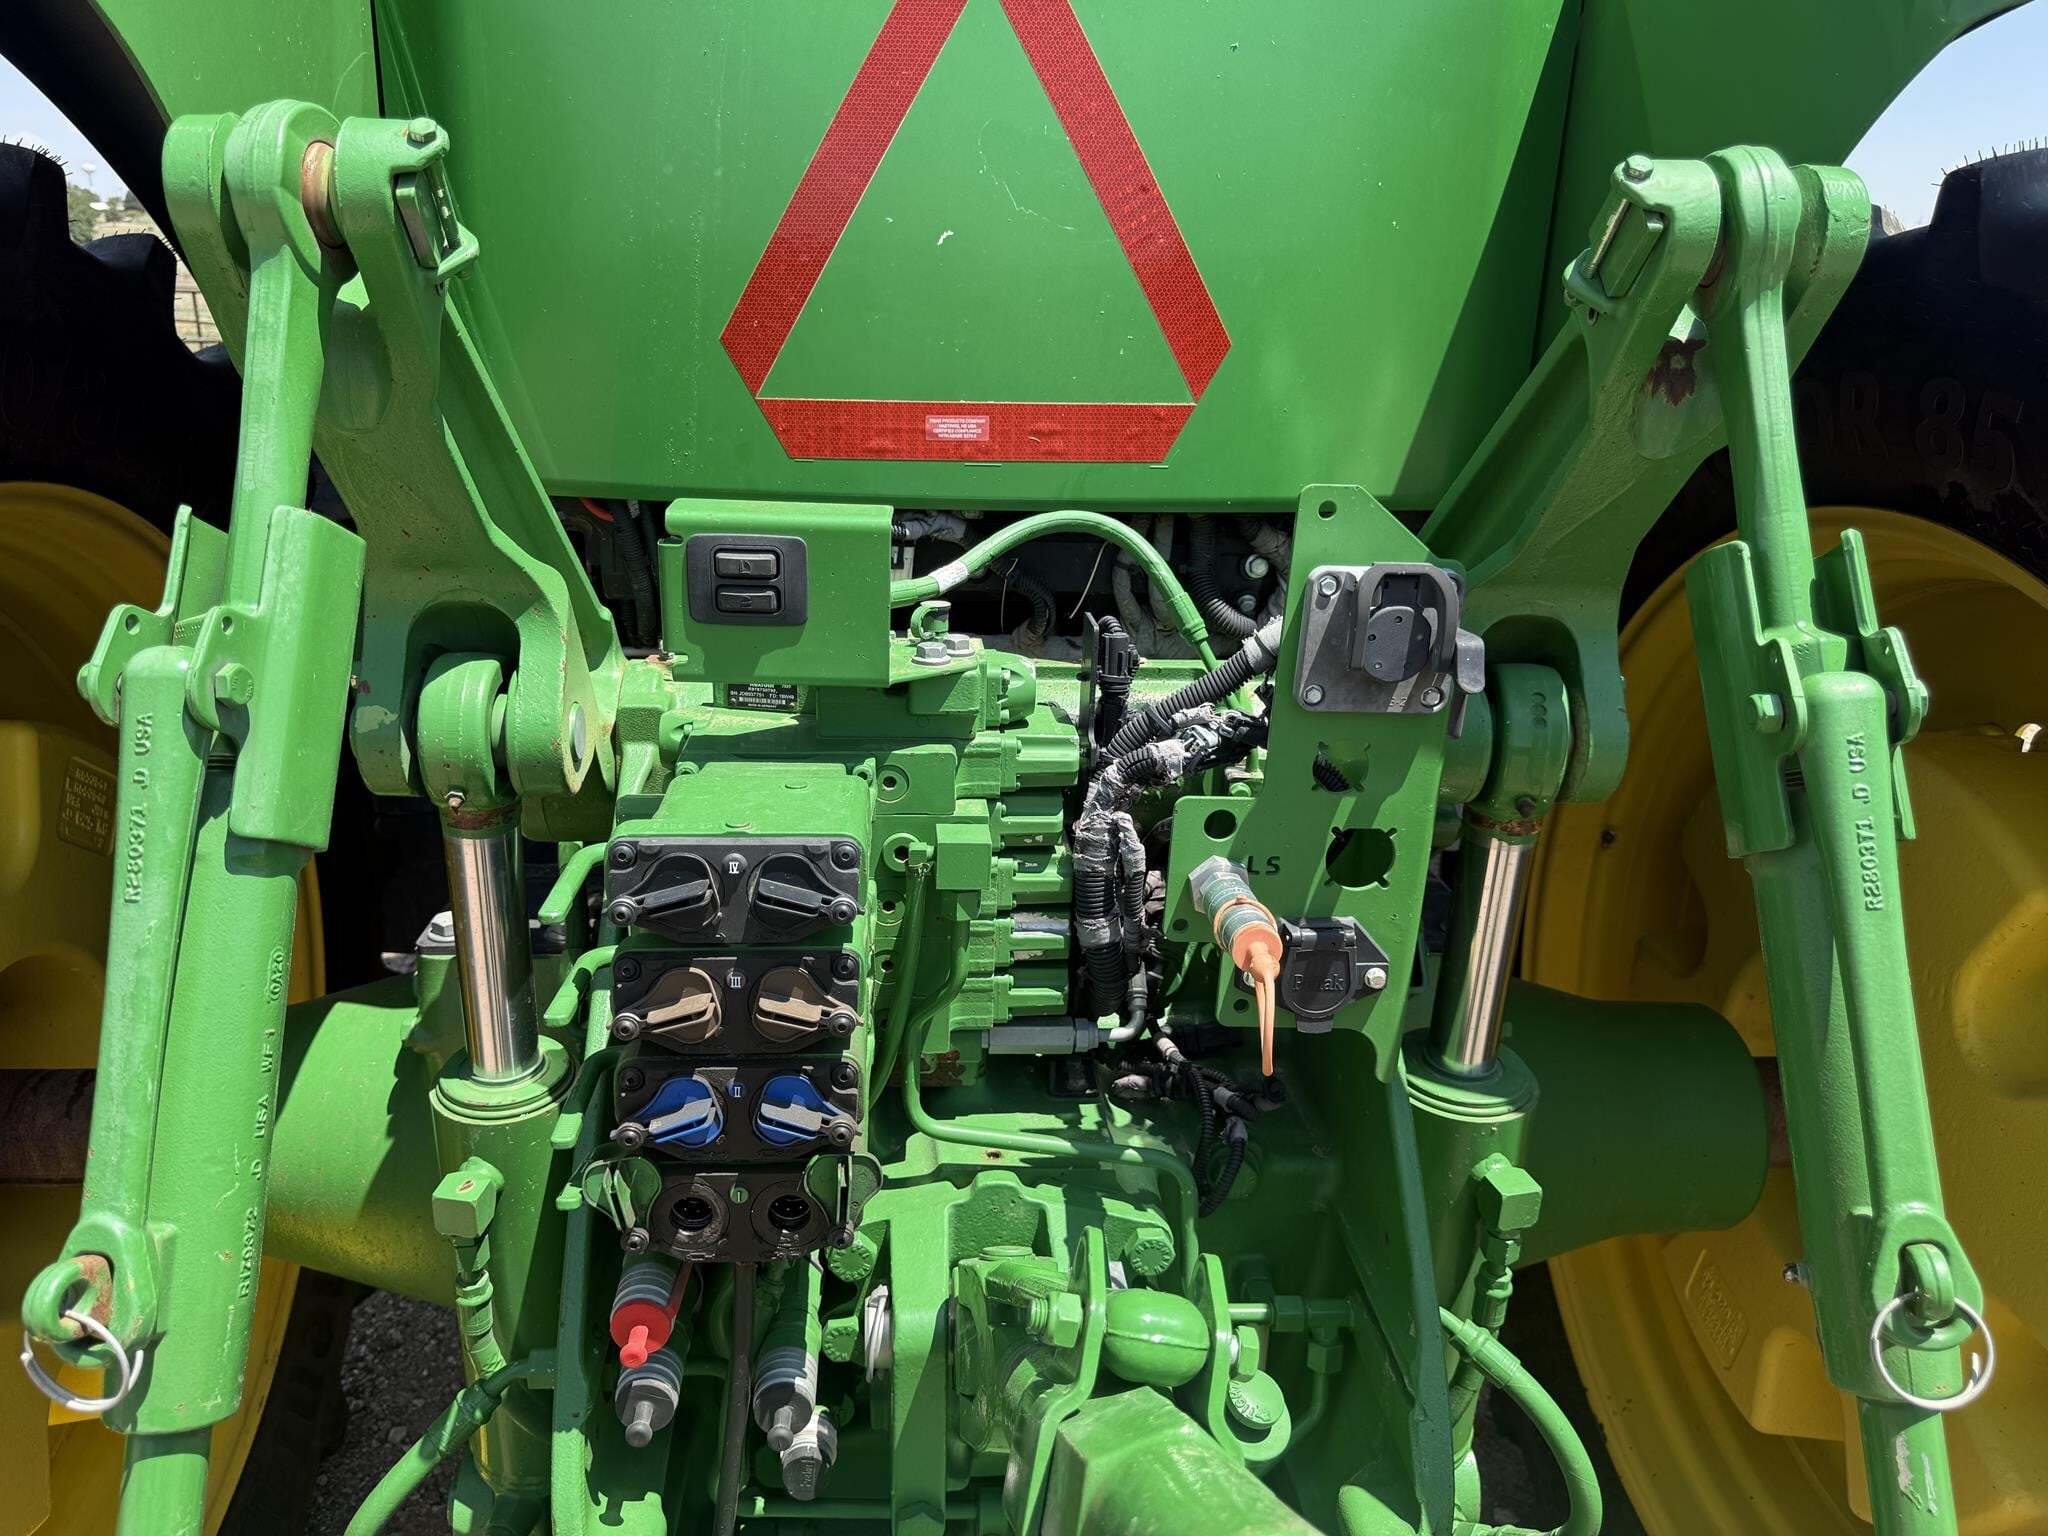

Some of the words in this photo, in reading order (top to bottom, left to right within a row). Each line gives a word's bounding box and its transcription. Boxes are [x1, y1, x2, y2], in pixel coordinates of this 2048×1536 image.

[133, 712, 153, 756] USA
[1846, 732, 1867, 774] USA
[729, 861, 740, 874] IV
[1247, 855, 1281, 876] LS
[1855, 816, 1884, 912] R280371
[730, 976, 742, 988] III
[733, 1086, 742, 1098] II
[253, 1094, 269, 1139] USA
